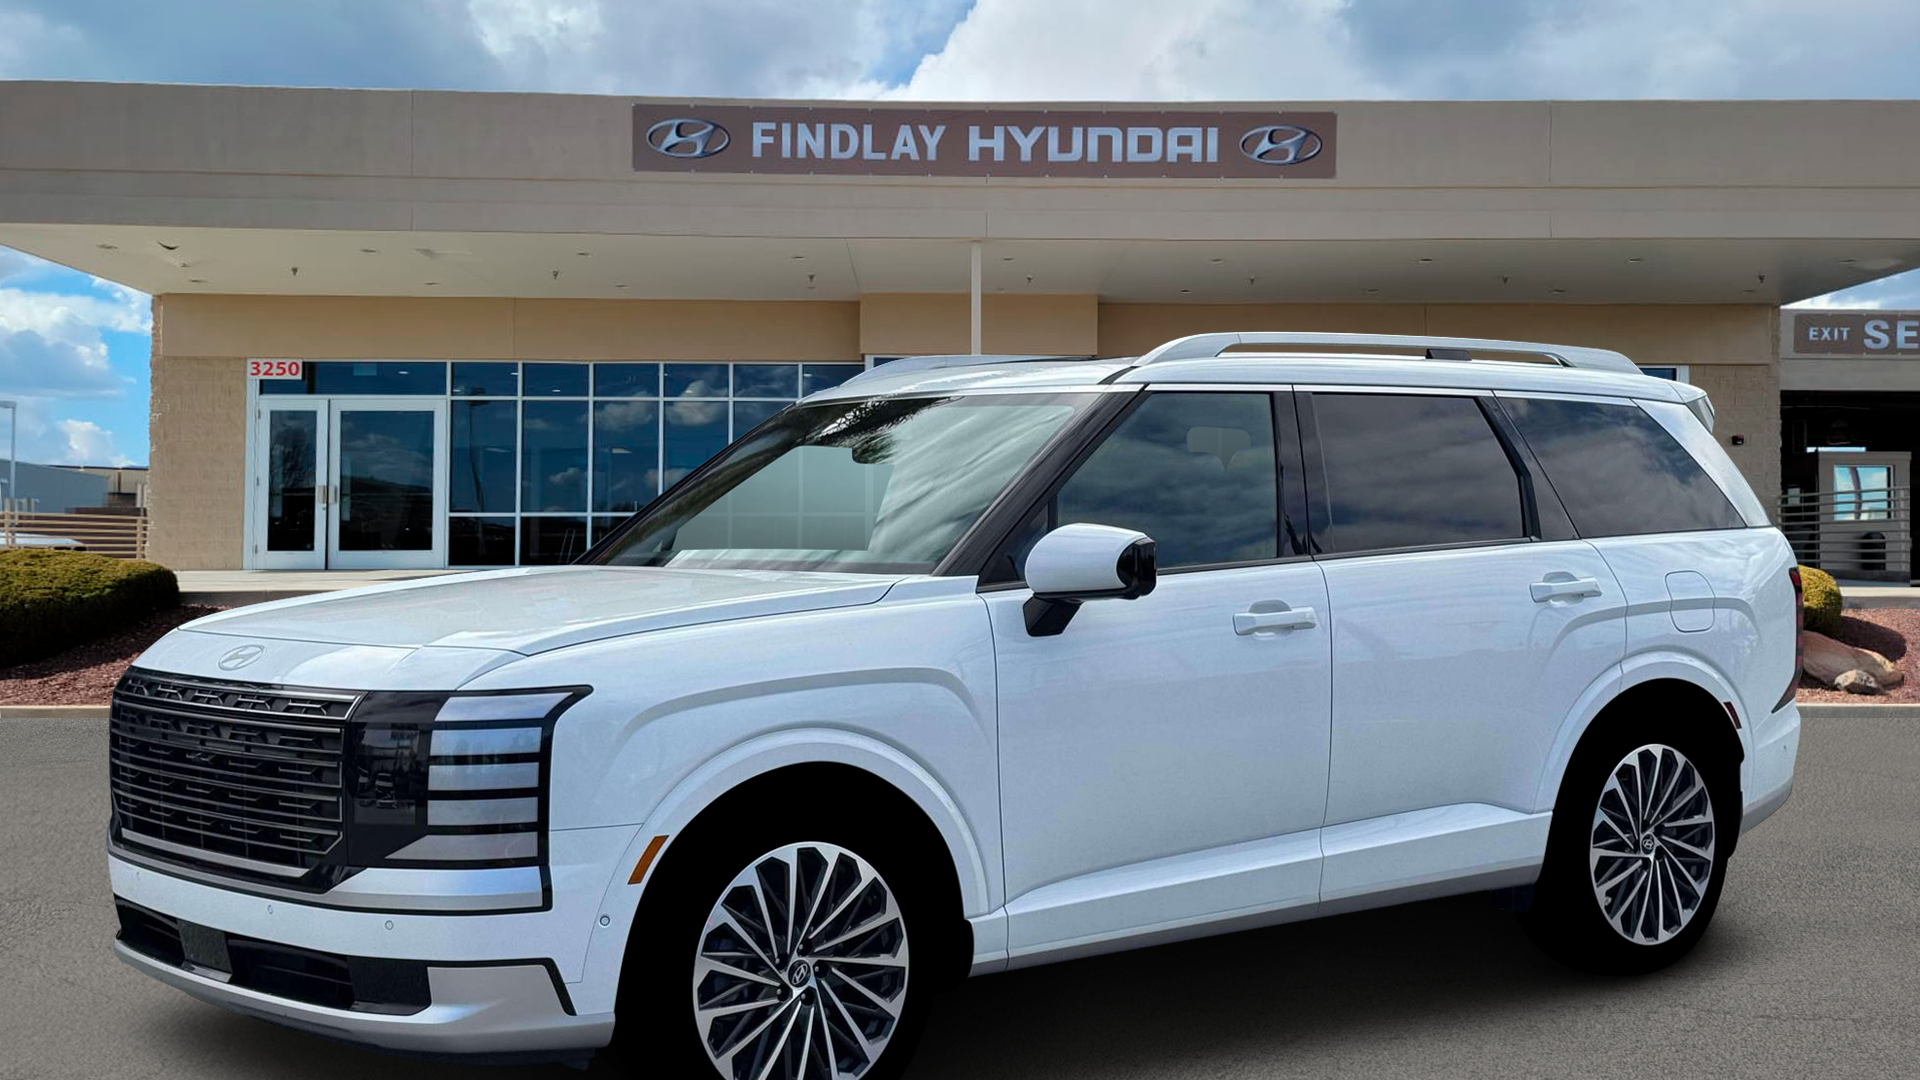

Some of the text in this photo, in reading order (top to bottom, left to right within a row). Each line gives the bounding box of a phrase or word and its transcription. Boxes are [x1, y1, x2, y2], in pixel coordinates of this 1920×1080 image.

[752, 122, 1219, 162] FINDLAY HYUNDAI
[1809, 327, 1850, 341] EXIT
[250, 361, 300, 376] 3250
